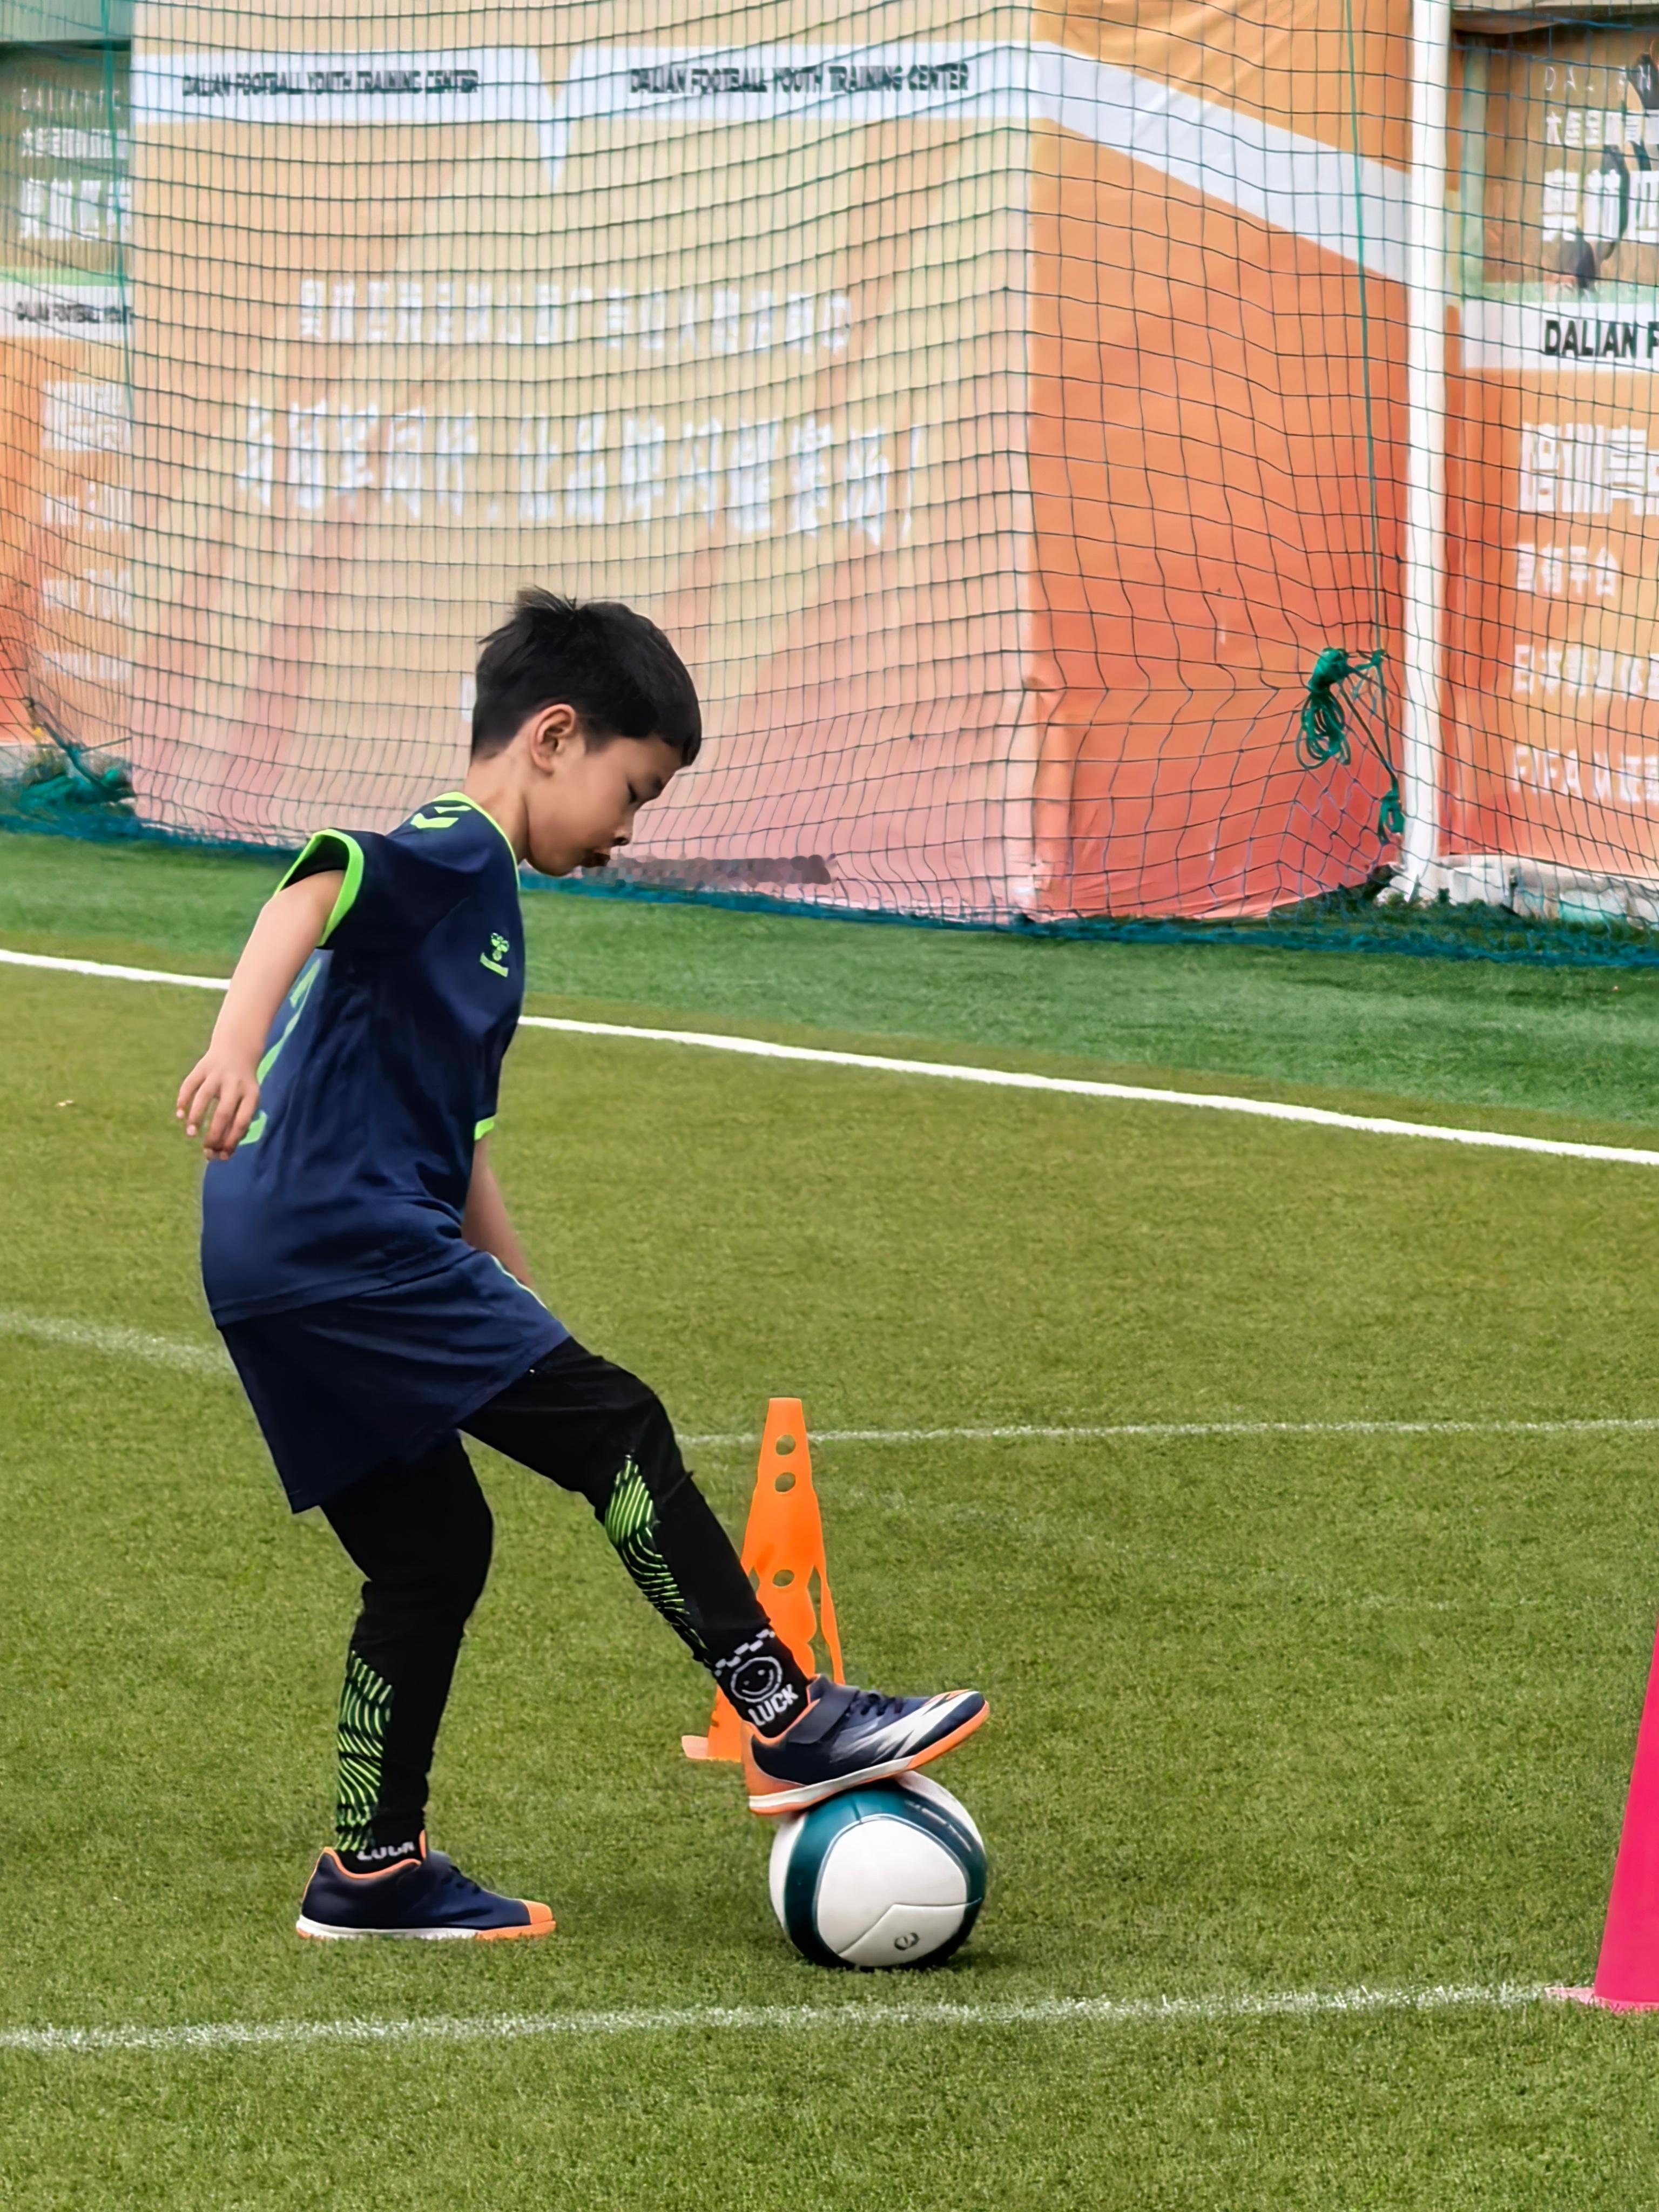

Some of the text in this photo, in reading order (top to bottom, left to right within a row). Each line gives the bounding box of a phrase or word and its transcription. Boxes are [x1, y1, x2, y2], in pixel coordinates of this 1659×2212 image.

[183, 72, 231, 97] DALIAN
[235, 72, 302, 96] FOOTBALL
[356, 70, 422, 94] TRAINING
[424, 69, 478, 93] CENTER
[631, 63, 968, 93] DALIAN FOOTBALL YOUTH TRAINING CENTER
[1545, 320, 1637, 359] DALIAN
[1513, 745, 1583, 800] FIFA
[747, 1683, 799, 1726] LUCK
